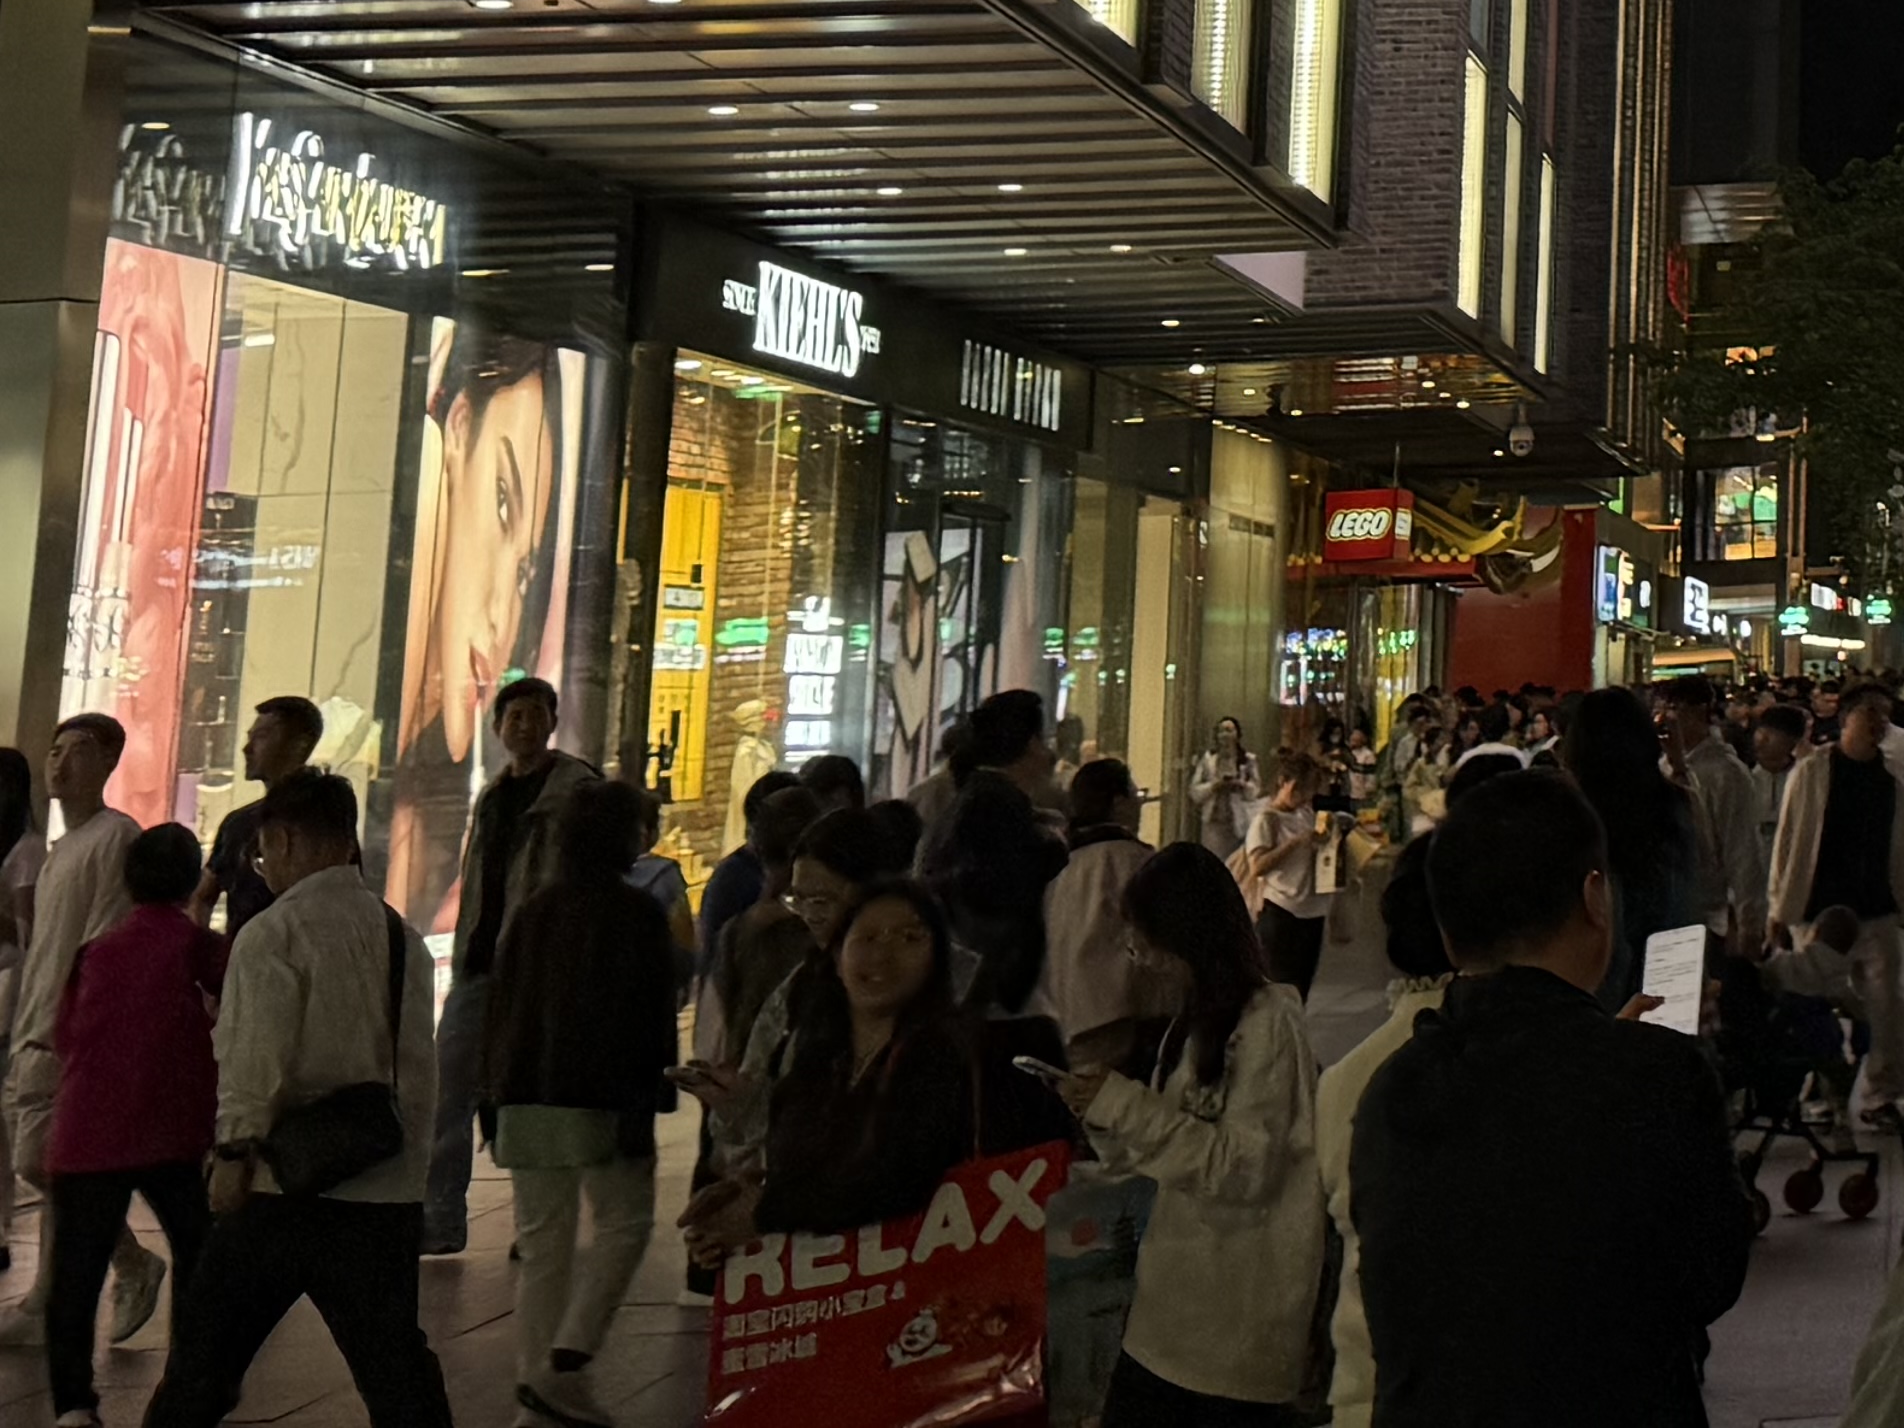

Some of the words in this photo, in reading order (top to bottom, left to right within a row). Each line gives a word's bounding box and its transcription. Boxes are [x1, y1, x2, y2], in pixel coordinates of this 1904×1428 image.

[752, 260, 863, 378] KIEHL'S
[1328, 509, 1391, 540] LEGO
[723, 1157, 1048, 1306] RELAX
